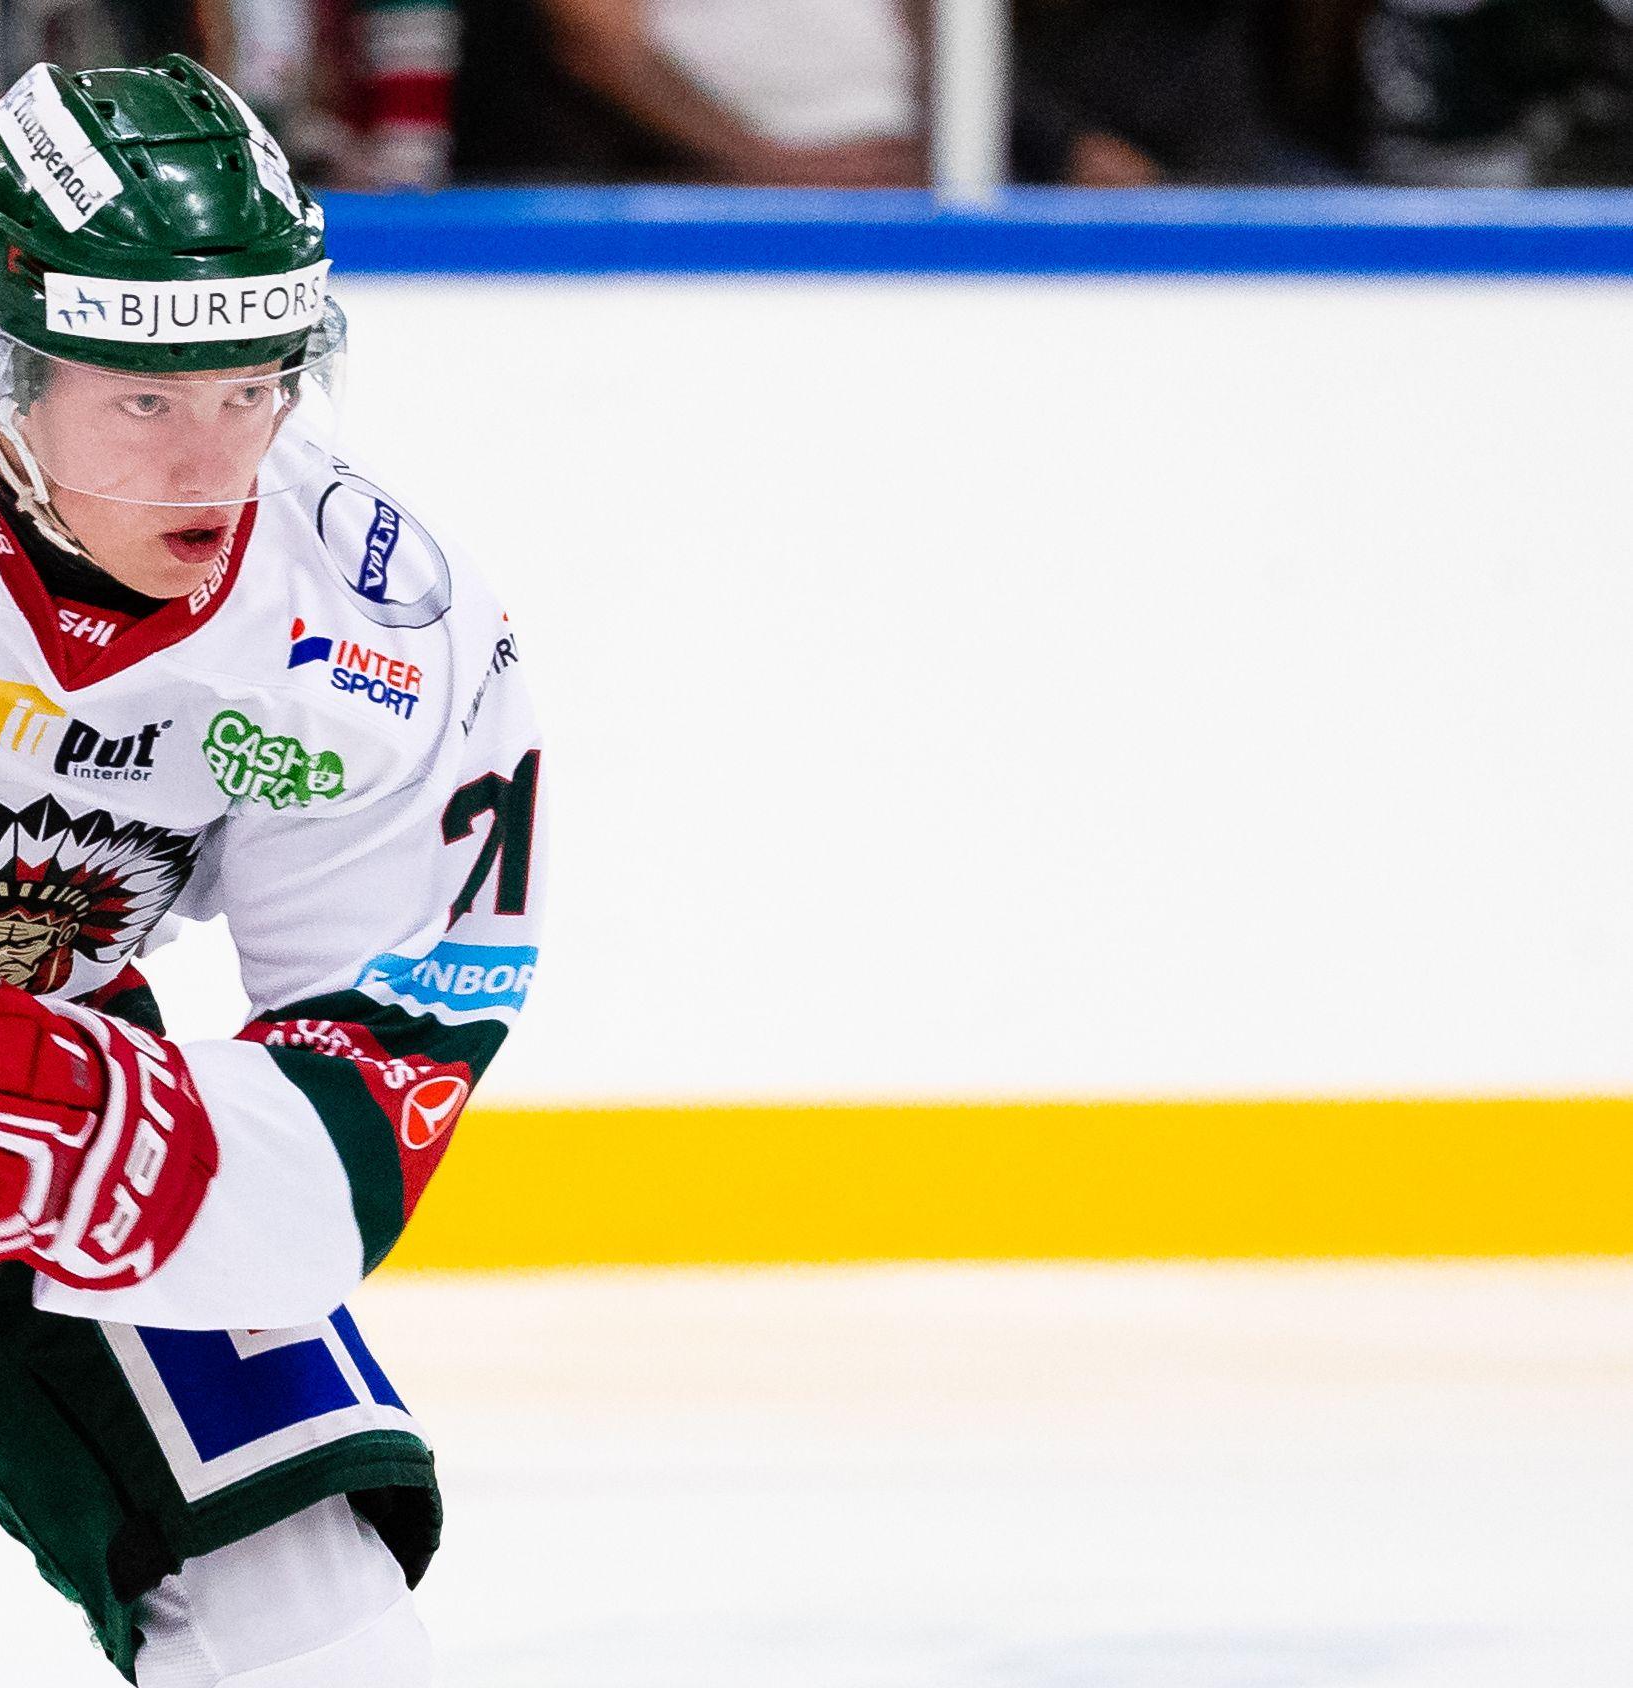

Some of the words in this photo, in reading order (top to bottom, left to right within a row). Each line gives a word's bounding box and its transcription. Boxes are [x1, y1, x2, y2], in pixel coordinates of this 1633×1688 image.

[120, 276, 321, 337] BJURFORS
[365, 505, 396, 592] VOLVO
[330, 667, 420, 720] SPORT
[336, 640, 423, 695] INTER
[440, 748, 542, 934] 21
